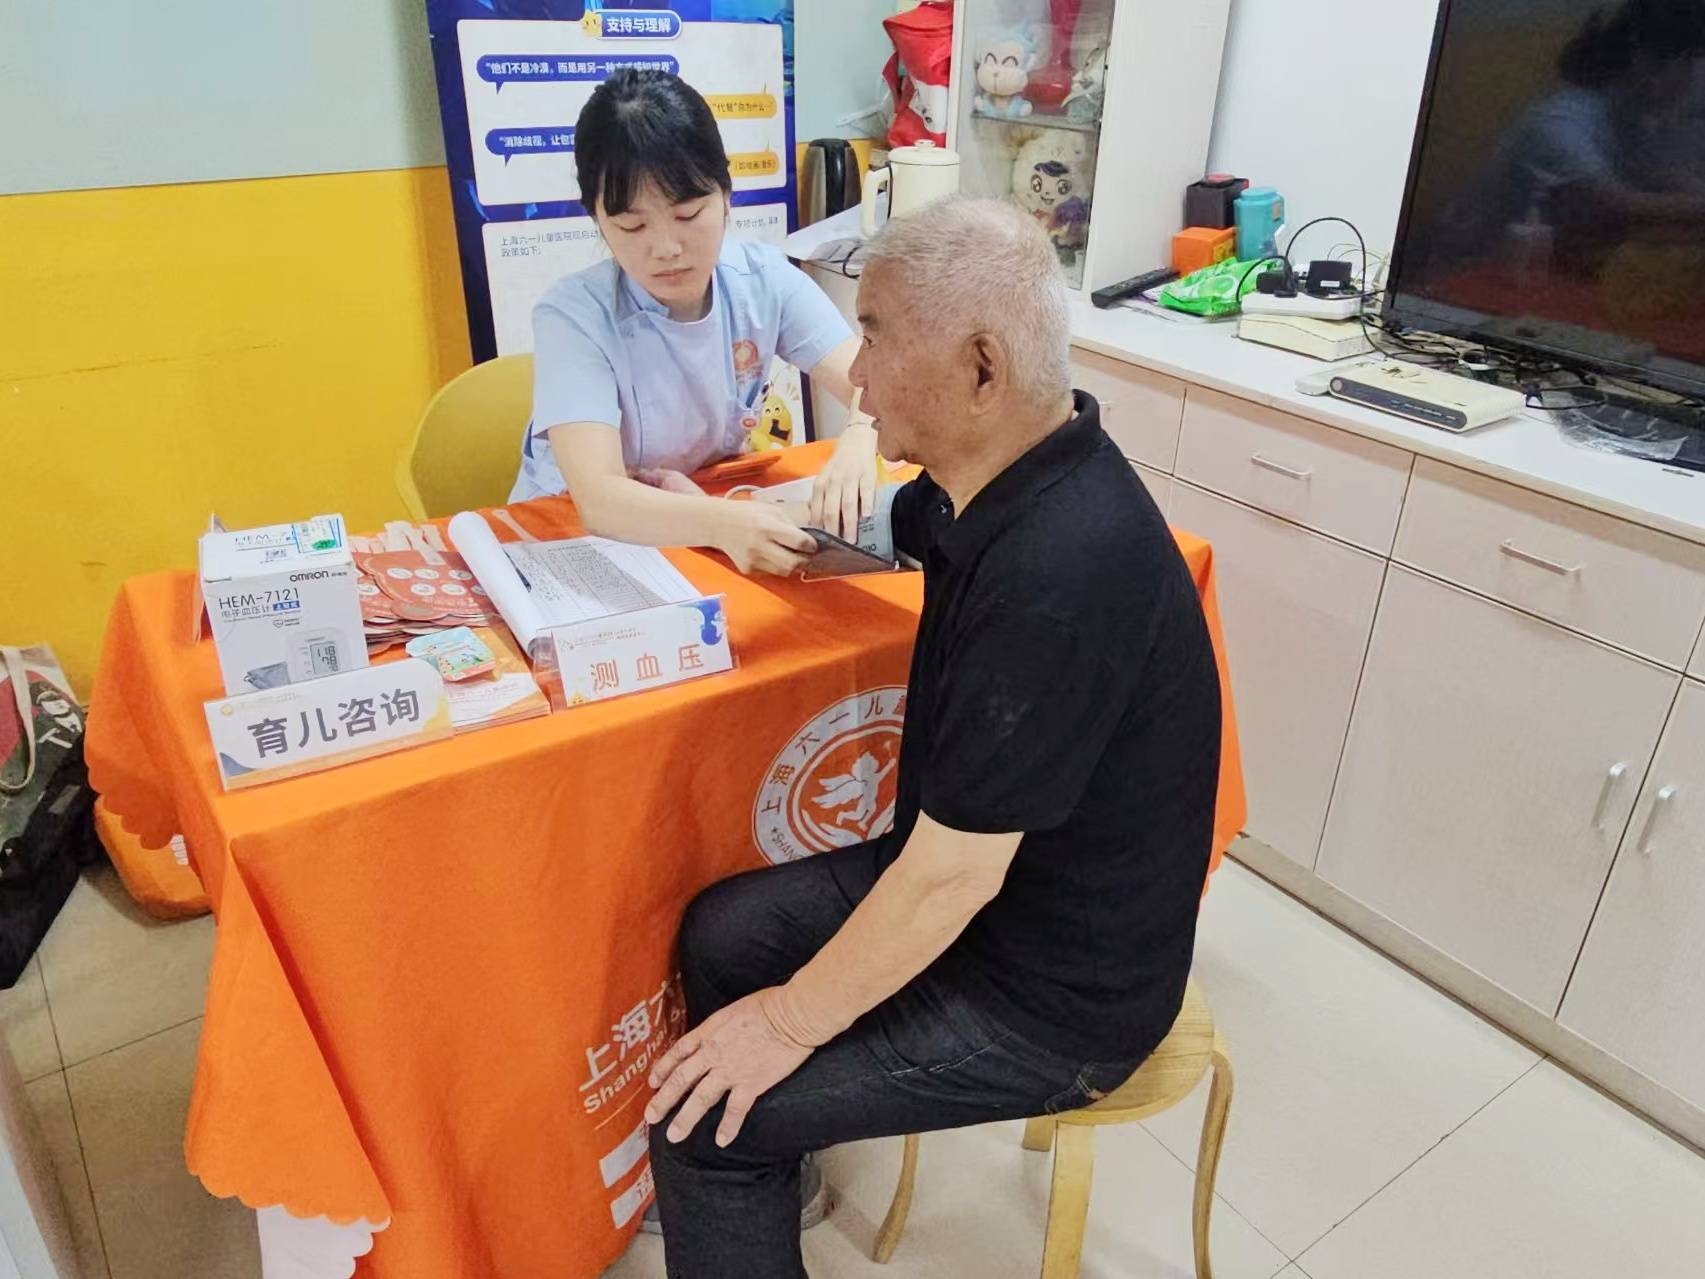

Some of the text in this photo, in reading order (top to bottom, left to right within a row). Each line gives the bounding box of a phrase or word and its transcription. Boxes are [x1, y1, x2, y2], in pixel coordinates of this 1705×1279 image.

[606, 17, 672, 33] 支持与理解
[289, 570, 329, 582] OMRON
[218, 587, 299, 609] HEM-7121
[590, 643, 704, 692] 测血压
[247, 688, 420, 759] 育儿咨询
